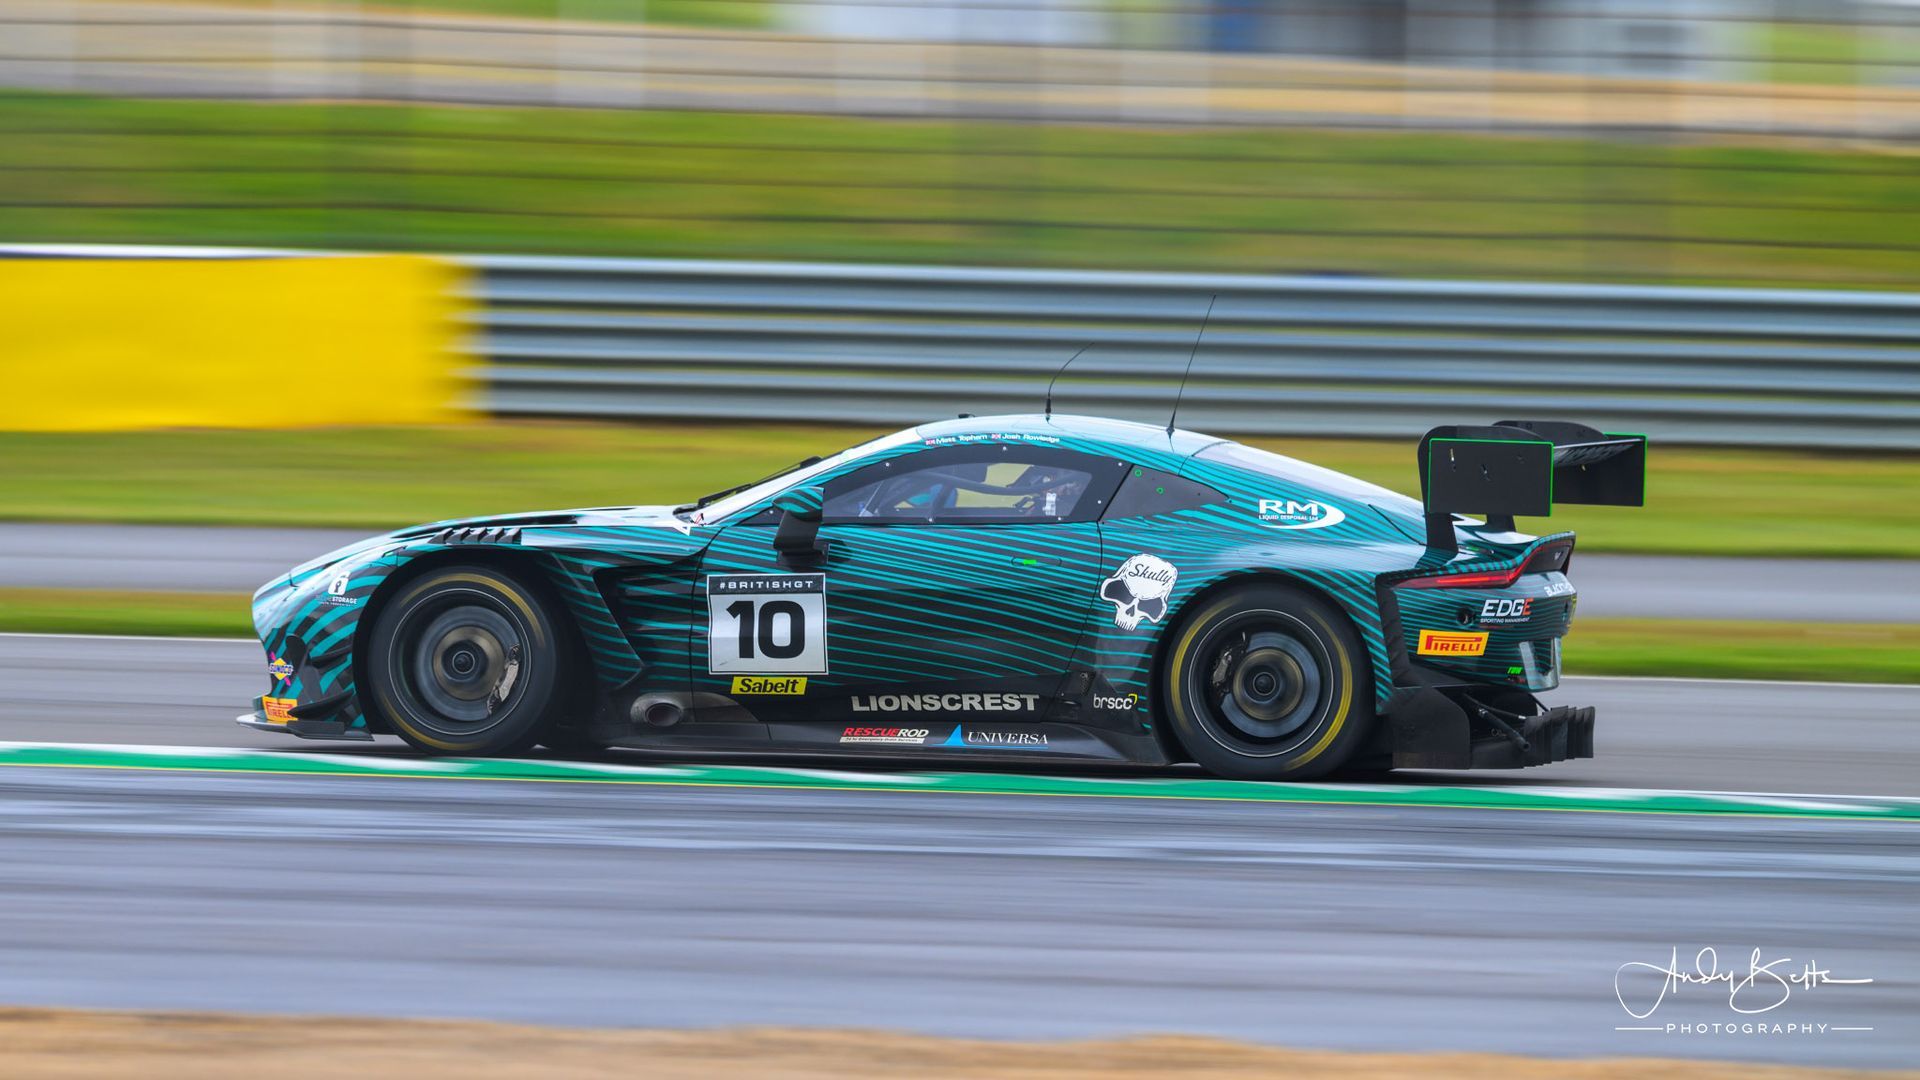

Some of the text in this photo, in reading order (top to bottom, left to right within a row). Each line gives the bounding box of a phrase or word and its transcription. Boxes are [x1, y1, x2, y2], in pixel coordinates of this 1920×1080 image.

[1259, 499, 1318, 515] RM
[1128, 563, 1173, 586] Skully
[720, 581, 814, 589] #BRITISHGT
[1481, 598, 1534, 617] EDGE
[726, 600, 806, 659] 10
[1425, 635, 1483, 651] PIRELLI
[739, 678, 799, 693] Sabelt
[851, 694, 1040, 712] LIONSCREST
[1093, 694, 1133, 710] brscc
[843, 727, 930, 738] RESCUEROD
[967, 731, 1049, 745] UNIVERSA
